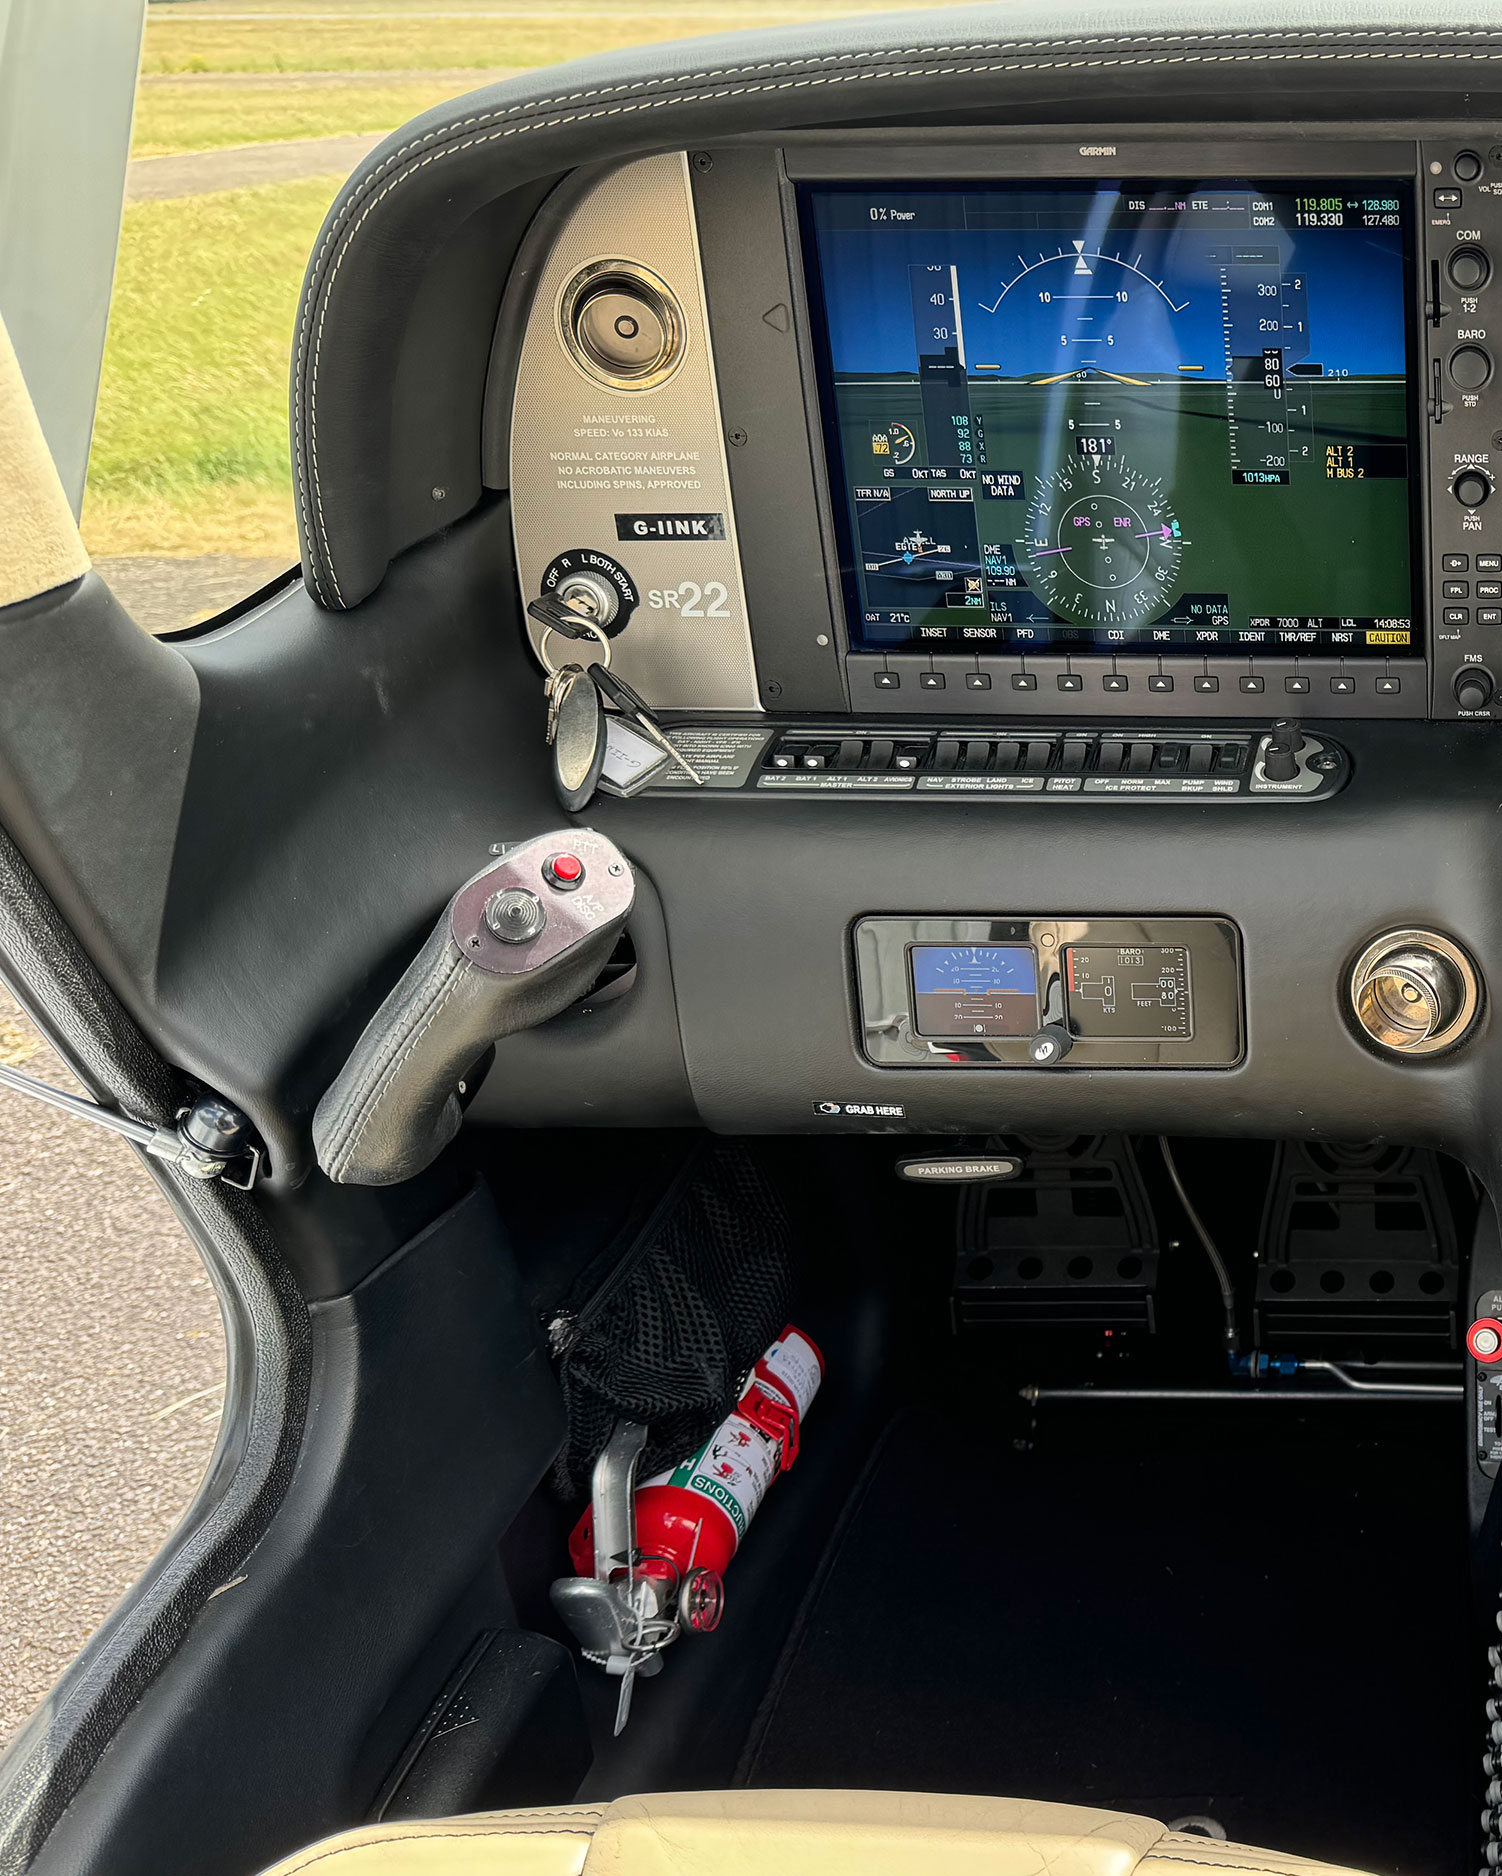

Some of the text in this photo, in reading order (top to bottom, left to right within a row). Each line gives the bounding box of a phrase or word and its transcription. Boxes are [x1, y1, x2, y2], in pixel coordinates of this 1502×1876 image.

[1079, 147, 1116, 156] GARMIN
[1253, 199, 1399, 211] COM1 119.805 128.980
[870, 208, 915, 221] 0% Power
[1253, 214, 1399, 226] COM2 119.330 127.480
[1456, 231, 1480, 240] COM
[1457, 330, 1486, 338] BARO
[583, 415, 655, 423] MANEUVERING
[574, 429, 609, 437] SPEED:
[627, 429, 643, 437] 133
[645, 429, 669, 437] KIAS
[595, 452, 648, 460] CATEGORY
[651, 452, 700, 460] AIRPLANE
[1454, 454, 1488, 463] RANGE
[575, 467, 632, 475] ACROBATIC
[983, 475, 1020, 485] NO WIND
[557, 481, 701, 490] INCLUDING SPINS, APPROVED
[991, 486, 1014, 496] DATA
[633, 520, 708, 535] G-IINK
[1462, 522, 1482, 531] PAN
[547, 554, 634, 602] OFF R L BOTH START
[1250, 618, 1410, 628] XPDR 7000 ALT 14:08:53
[921, 628, 1033, 638] INSET SENSOR PFD
[1108, 630, 1124, 639] CDI
[1153, 632, 1407, 643] DME XPDR IDENT TMR/REF NRST CAUTION
[846, 1105, 903, 1116] GRAB HERE
[919, 1165, 999, 1175] PARKING BRAKE
